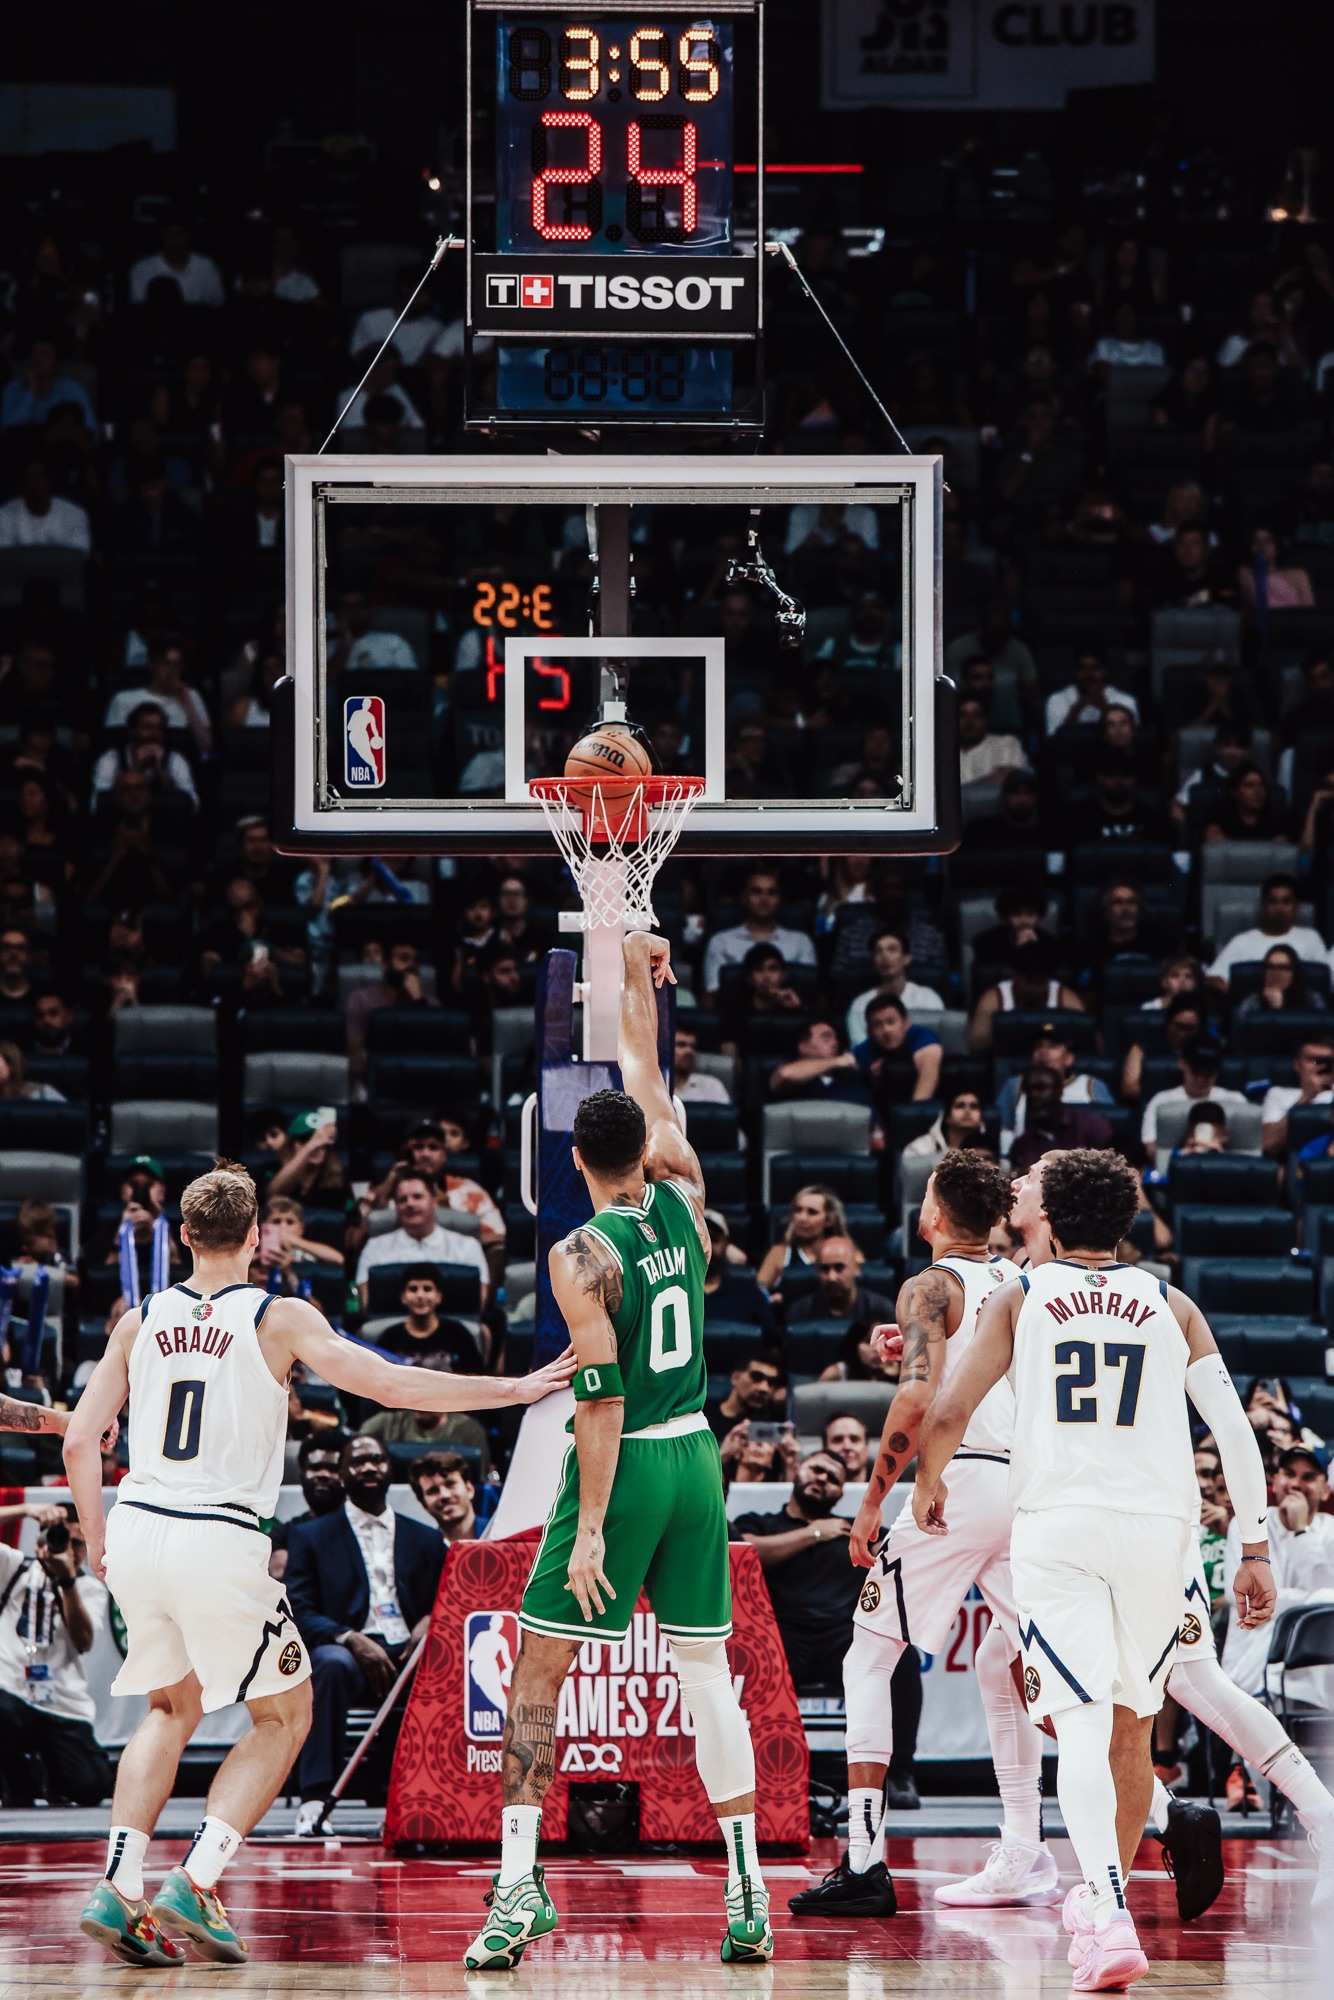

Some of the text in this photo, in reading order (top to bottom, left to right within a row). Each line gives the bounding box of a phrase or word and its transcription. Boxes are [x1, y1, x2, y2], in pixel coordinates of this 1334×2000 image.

[993, 4, 1137, 46] CLUB
[564, 27, 719, 102] 3:55
[532, 112, 697, 241] 24
[558, 275, 745, 311] TISSOT
[351, 766, 371, 782] NBA
[637, 1246, 686, 1286] TATUM
[649, 1285, 693, 1374] 0
[1044, 1290, 1158, 1328] MURRAY
[155, 1325, 235, 1360] BRAUN
[584, 1368, 602, 1392] 0
[1053, 1339, 1147, 1429] 27
[161, 1378, 206, 1463] 0
[609, 1612, 679, 1674] DHA
[473, 1711, 501, 1732] NBA
[556, 1674, 649, 1737] AMES
[560, 1743, 623, 1773] ADQ
